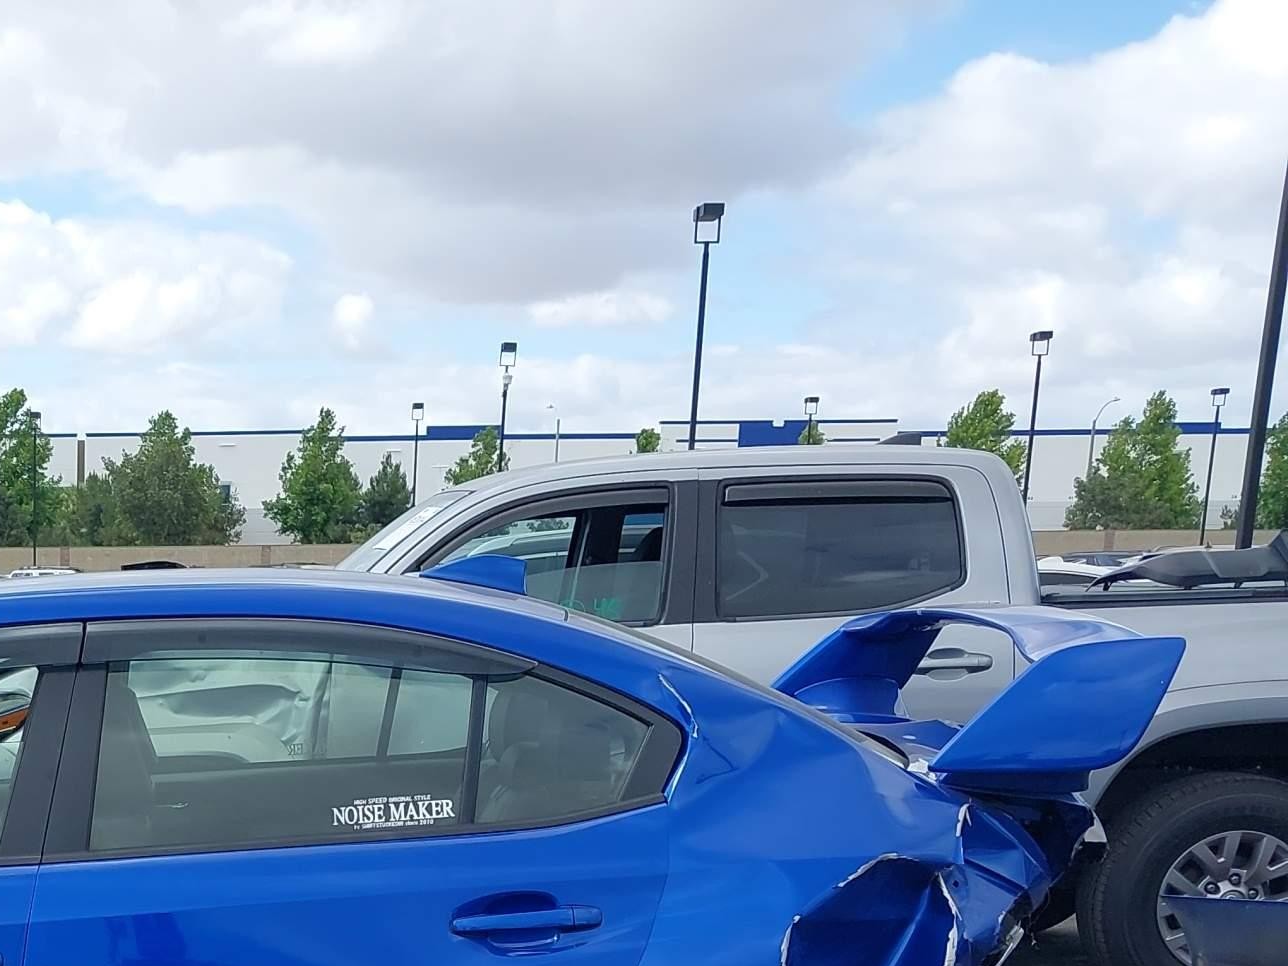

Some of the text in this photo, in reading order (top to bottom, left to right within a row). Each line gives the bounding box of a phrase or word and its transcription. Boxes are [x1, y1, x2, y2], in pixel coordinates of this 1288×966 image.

[368, 797, 388, 805] SPEED
[332, 800, 456, 826] NOISE MAKER
